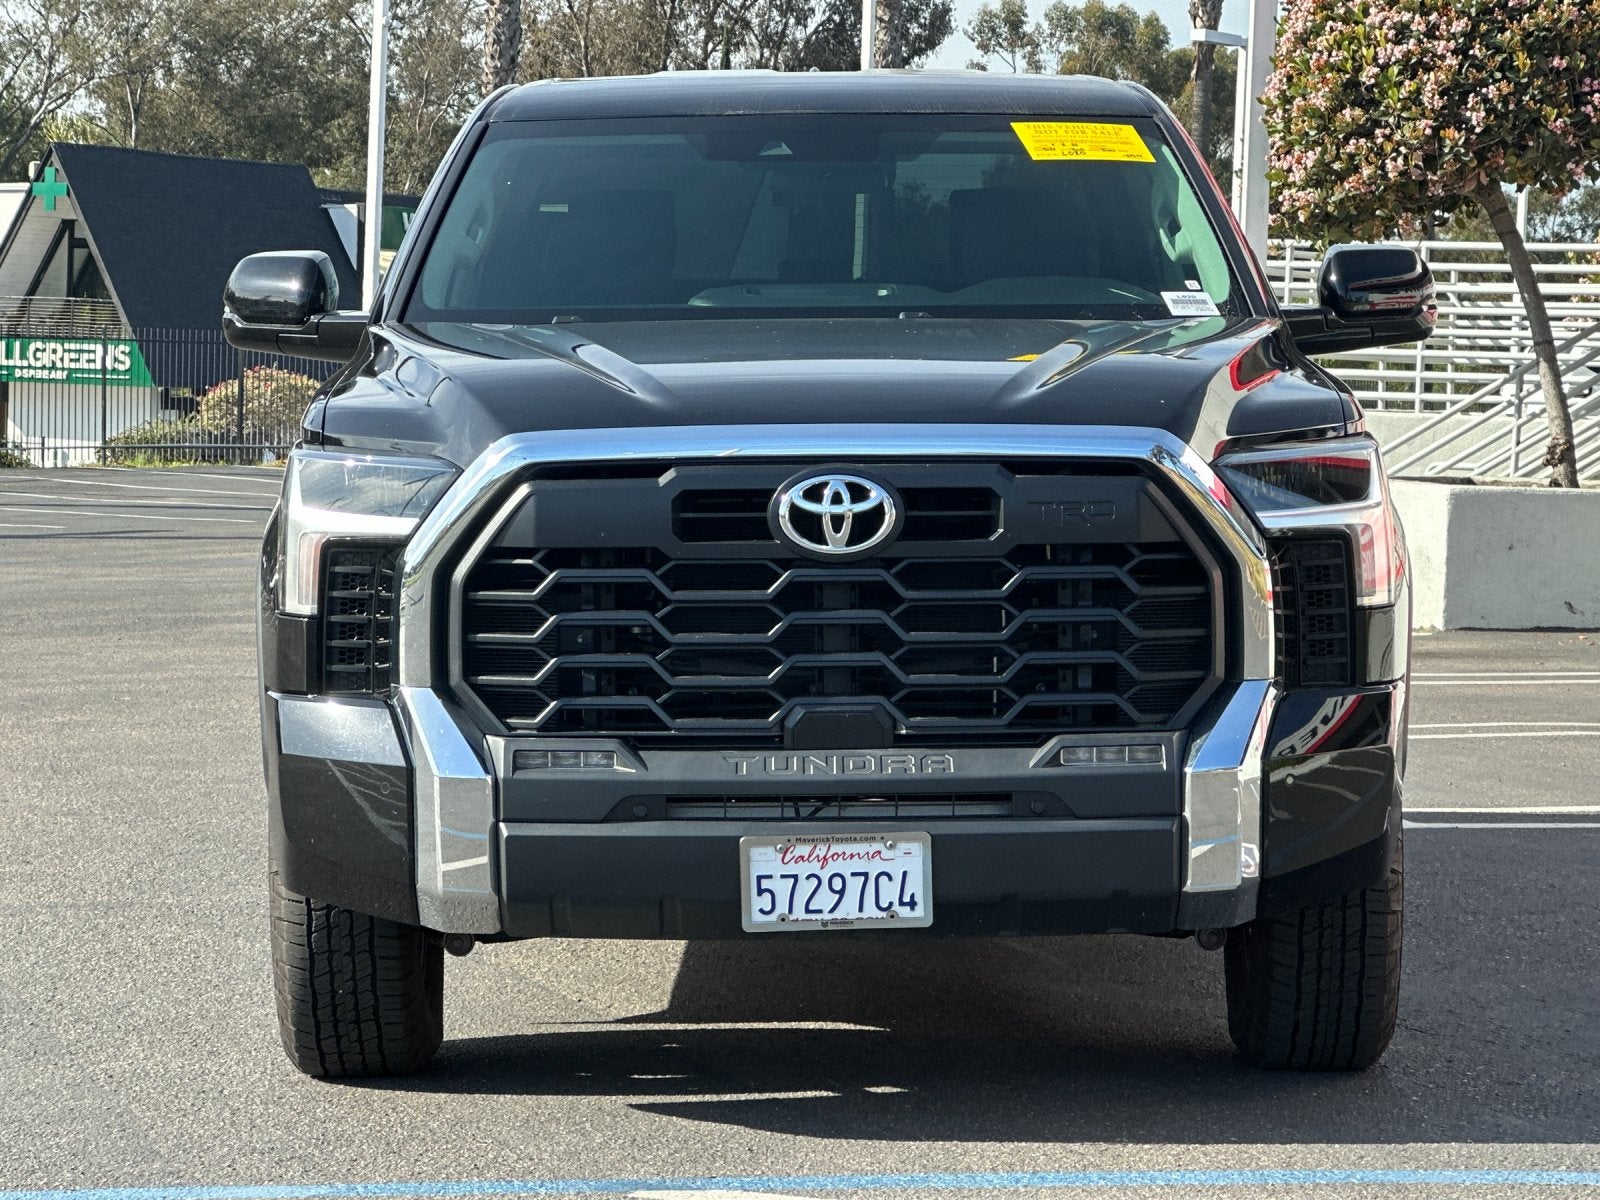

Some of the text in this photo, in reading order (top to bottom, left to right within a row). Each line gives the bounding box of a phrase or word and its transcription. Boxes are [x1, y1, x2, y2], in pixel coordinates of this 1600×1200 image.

[14, 368, 69, 380] DSPENSARY
[1027, 500, 1116, 527] TRD
[722, 754, 955, 775] TUNDRA
[795, 835, 876, 843] MaverickToyota.com
[780, 843, 895, 870] California
[756, 870, 917, 916] 57297C4
